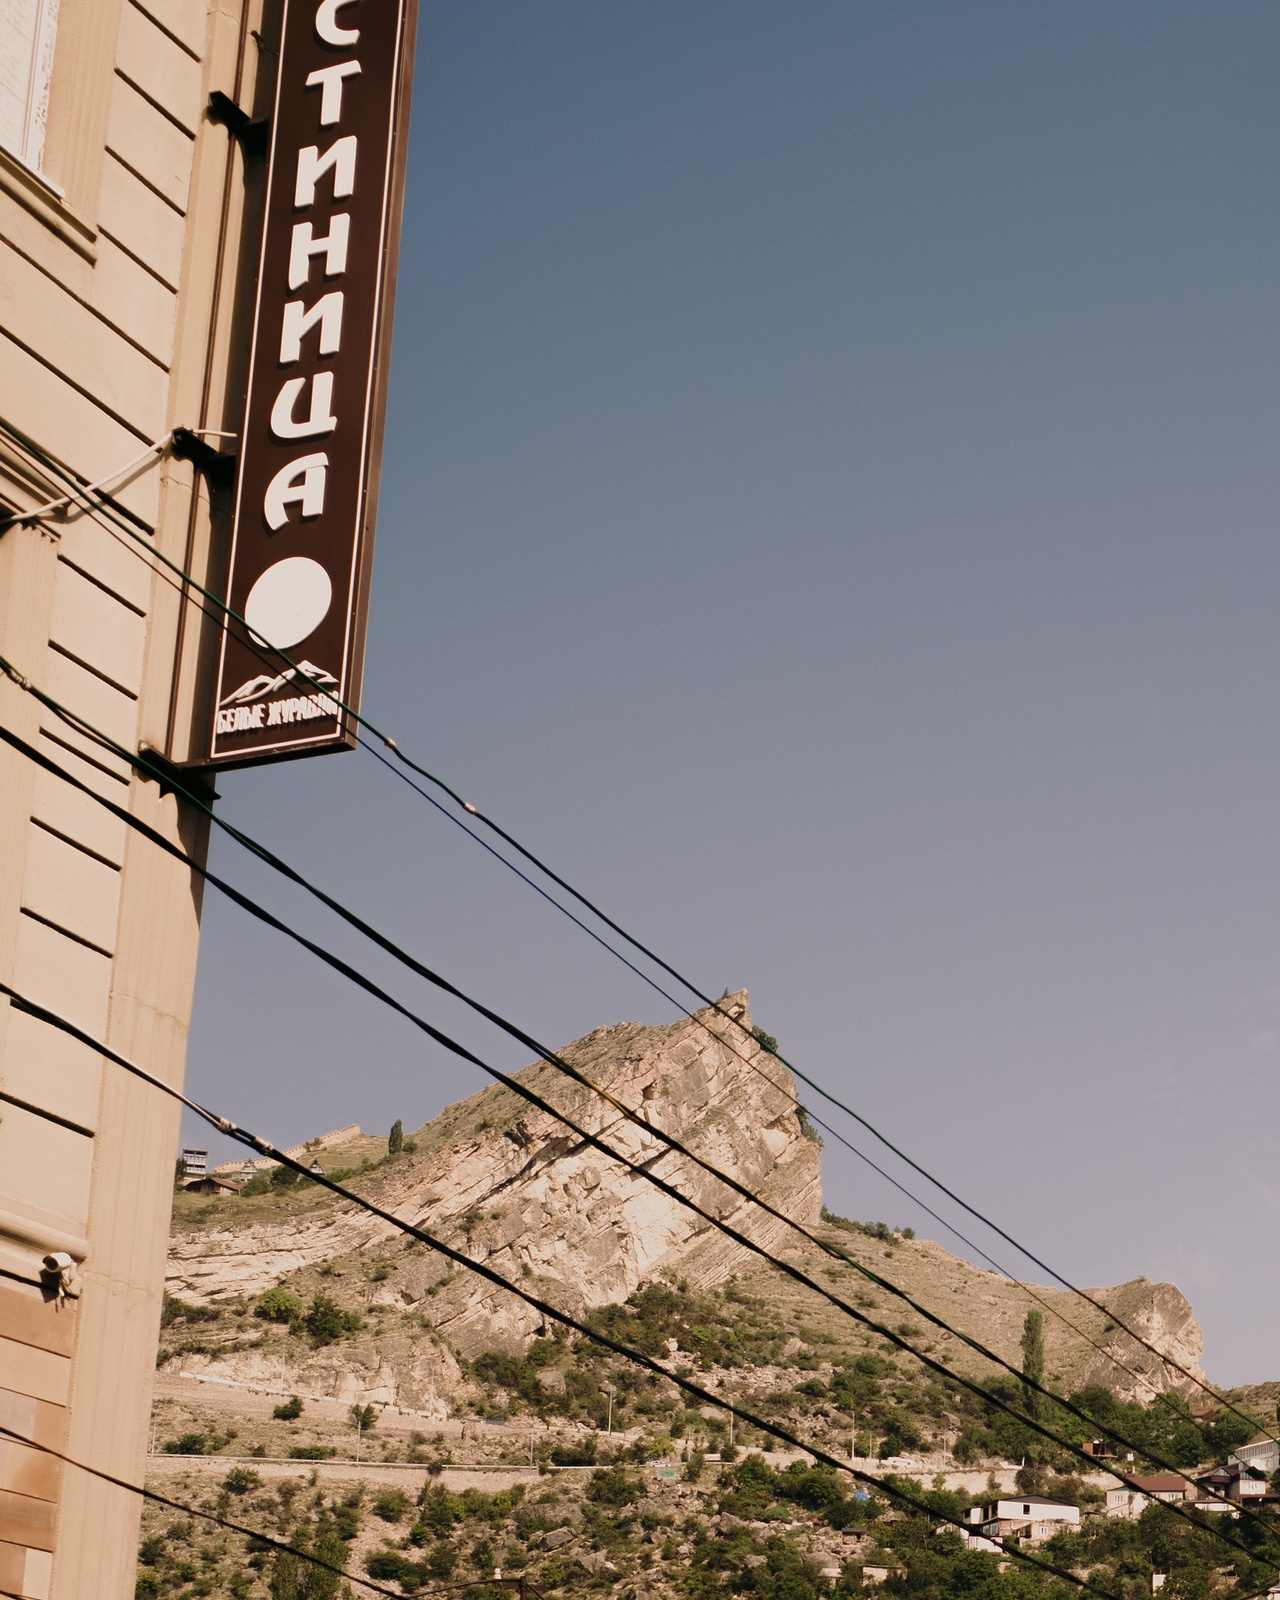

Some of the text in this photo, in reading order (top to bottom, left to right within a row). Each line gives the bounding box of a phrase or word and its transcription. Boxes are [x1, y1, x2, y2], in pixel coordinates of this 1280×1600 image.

[264, 0, 362, 532] СТИНИЦА
[216, 690, 339, 734] БЕЛЫЕ ЖУРАВЛИ
